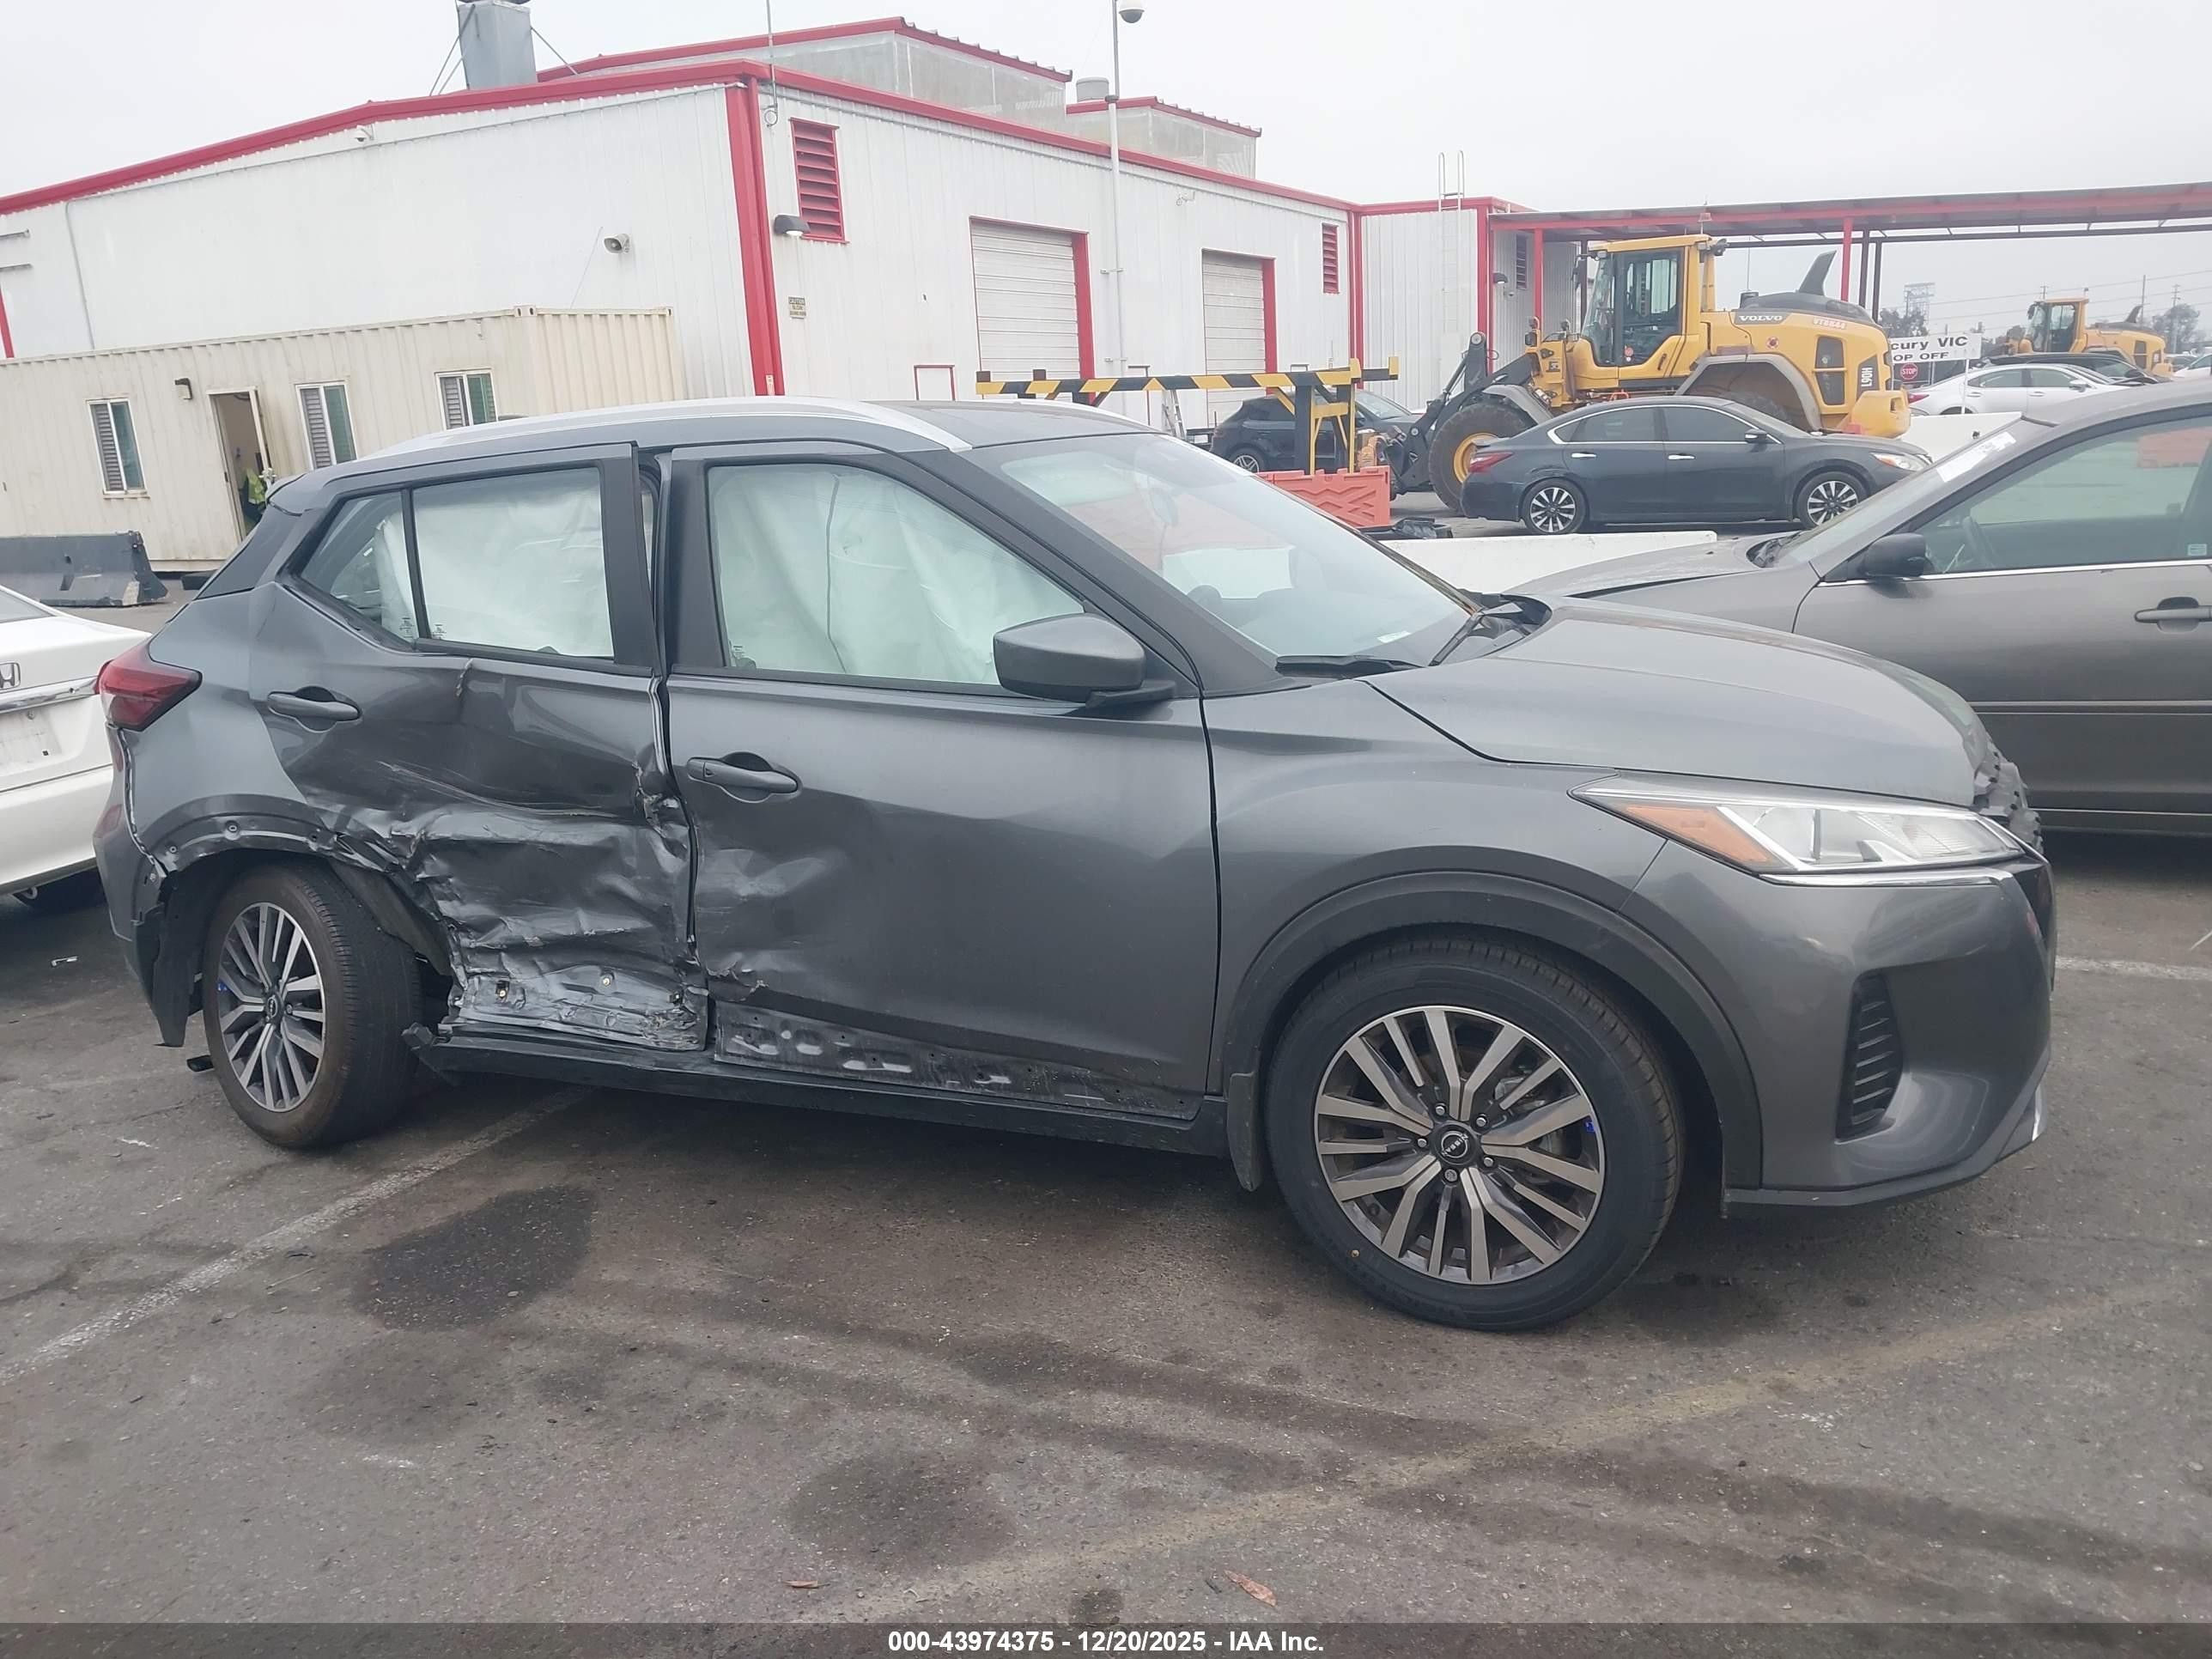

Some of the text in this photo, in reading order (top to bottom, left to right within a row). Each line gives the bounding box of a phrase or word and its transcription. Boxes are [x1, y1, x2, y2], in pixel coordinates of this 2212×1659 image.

[1937, 336, 1968, 348] VIC
[1919, 351, 1949, 360] OFF
[1861, 367, 1873, 387] L90H
[1442, 1133, 1468, 1157] NISSAN
